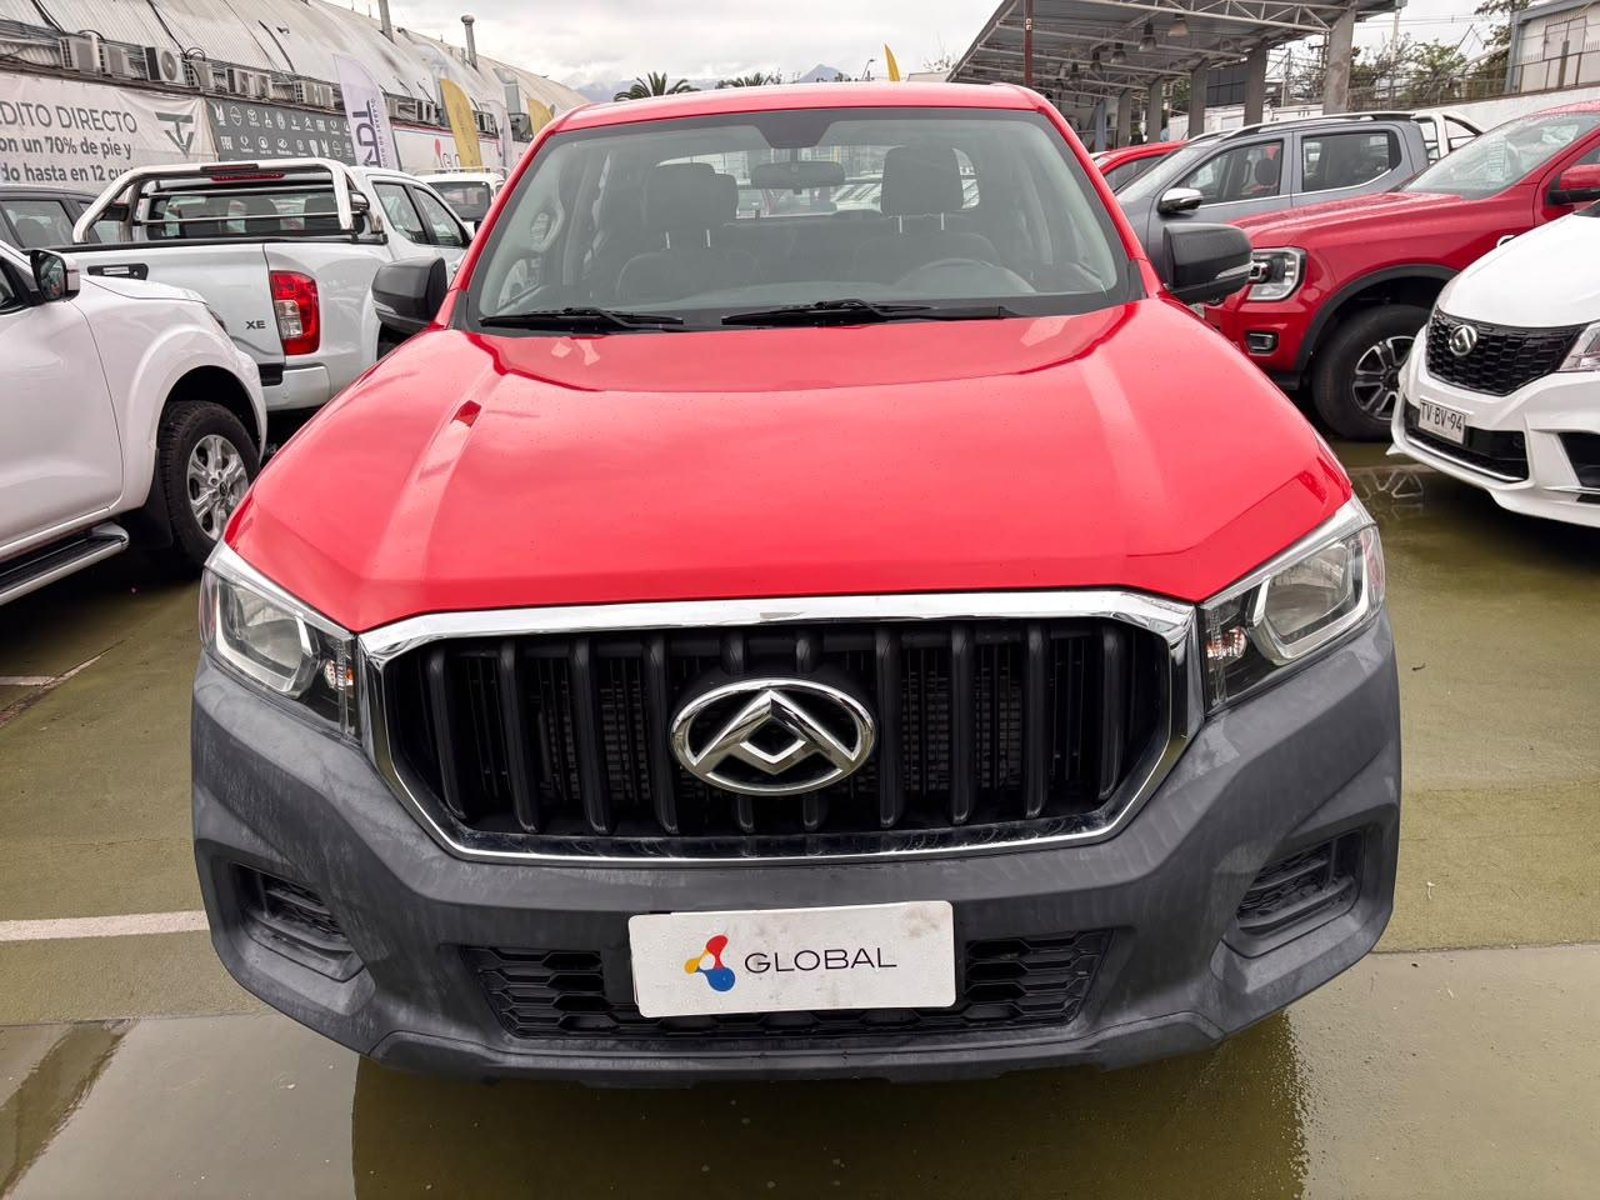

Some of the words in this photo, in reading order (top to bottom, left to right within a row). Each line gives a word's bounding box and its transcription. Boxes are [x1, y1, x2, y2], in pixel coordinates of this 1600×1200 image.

[0, 101, 52, 128] DITO
[55, 105, 138, 133] DIRECTO
[21, 138, 43, 153] un
[44, 136, 77, 154] 70%
[80, 136, 98, 154] de
[100, 137, 121, 159] pie
[123, 143, 131, 160] y
[23, 162, 67, 181] hasta
[70, 167, 89, 181] en
[90, 164, 105, 181] 12
[108, 167, 133, 181] cu
[245, 320, 266, 330] XE
[744, 947, 898, 974] GLOBAL
